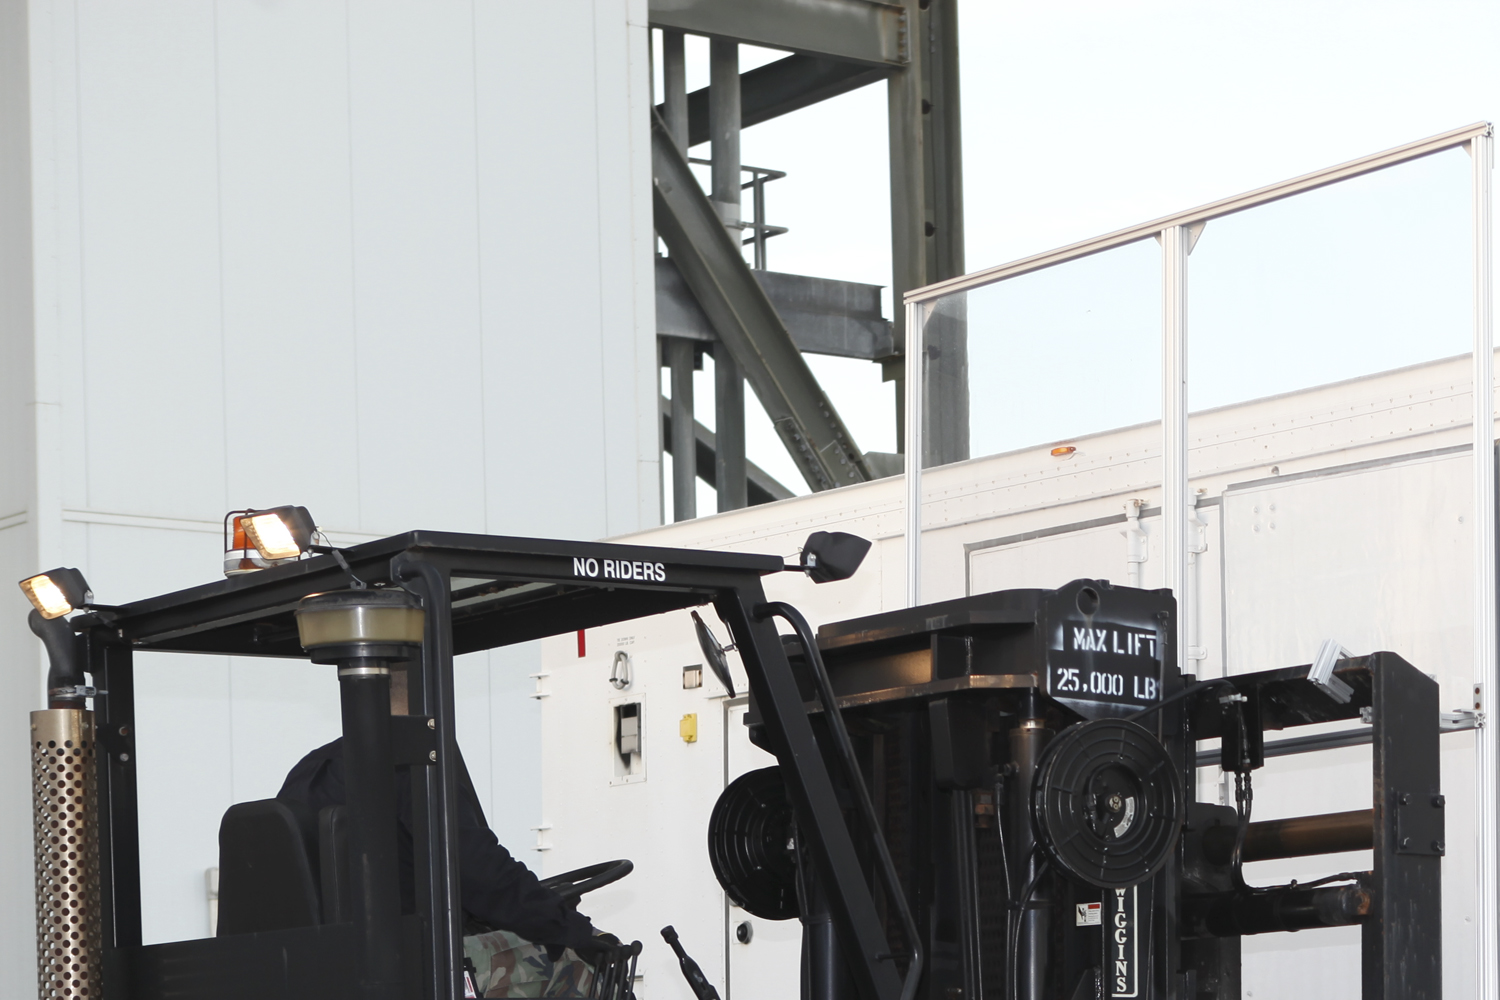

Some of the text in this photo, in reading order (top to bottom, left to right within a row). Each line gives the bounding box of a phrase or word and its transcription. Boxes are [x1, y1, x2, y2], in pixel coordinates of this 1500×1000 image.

[573, 557, 666, 582] NO RIDERS
[1073, 626, 1156, 658] MAX LIFT
[1057, 667, 1124, 696] 25,000
[1114, 888, 1128, 992] WIGGINS
